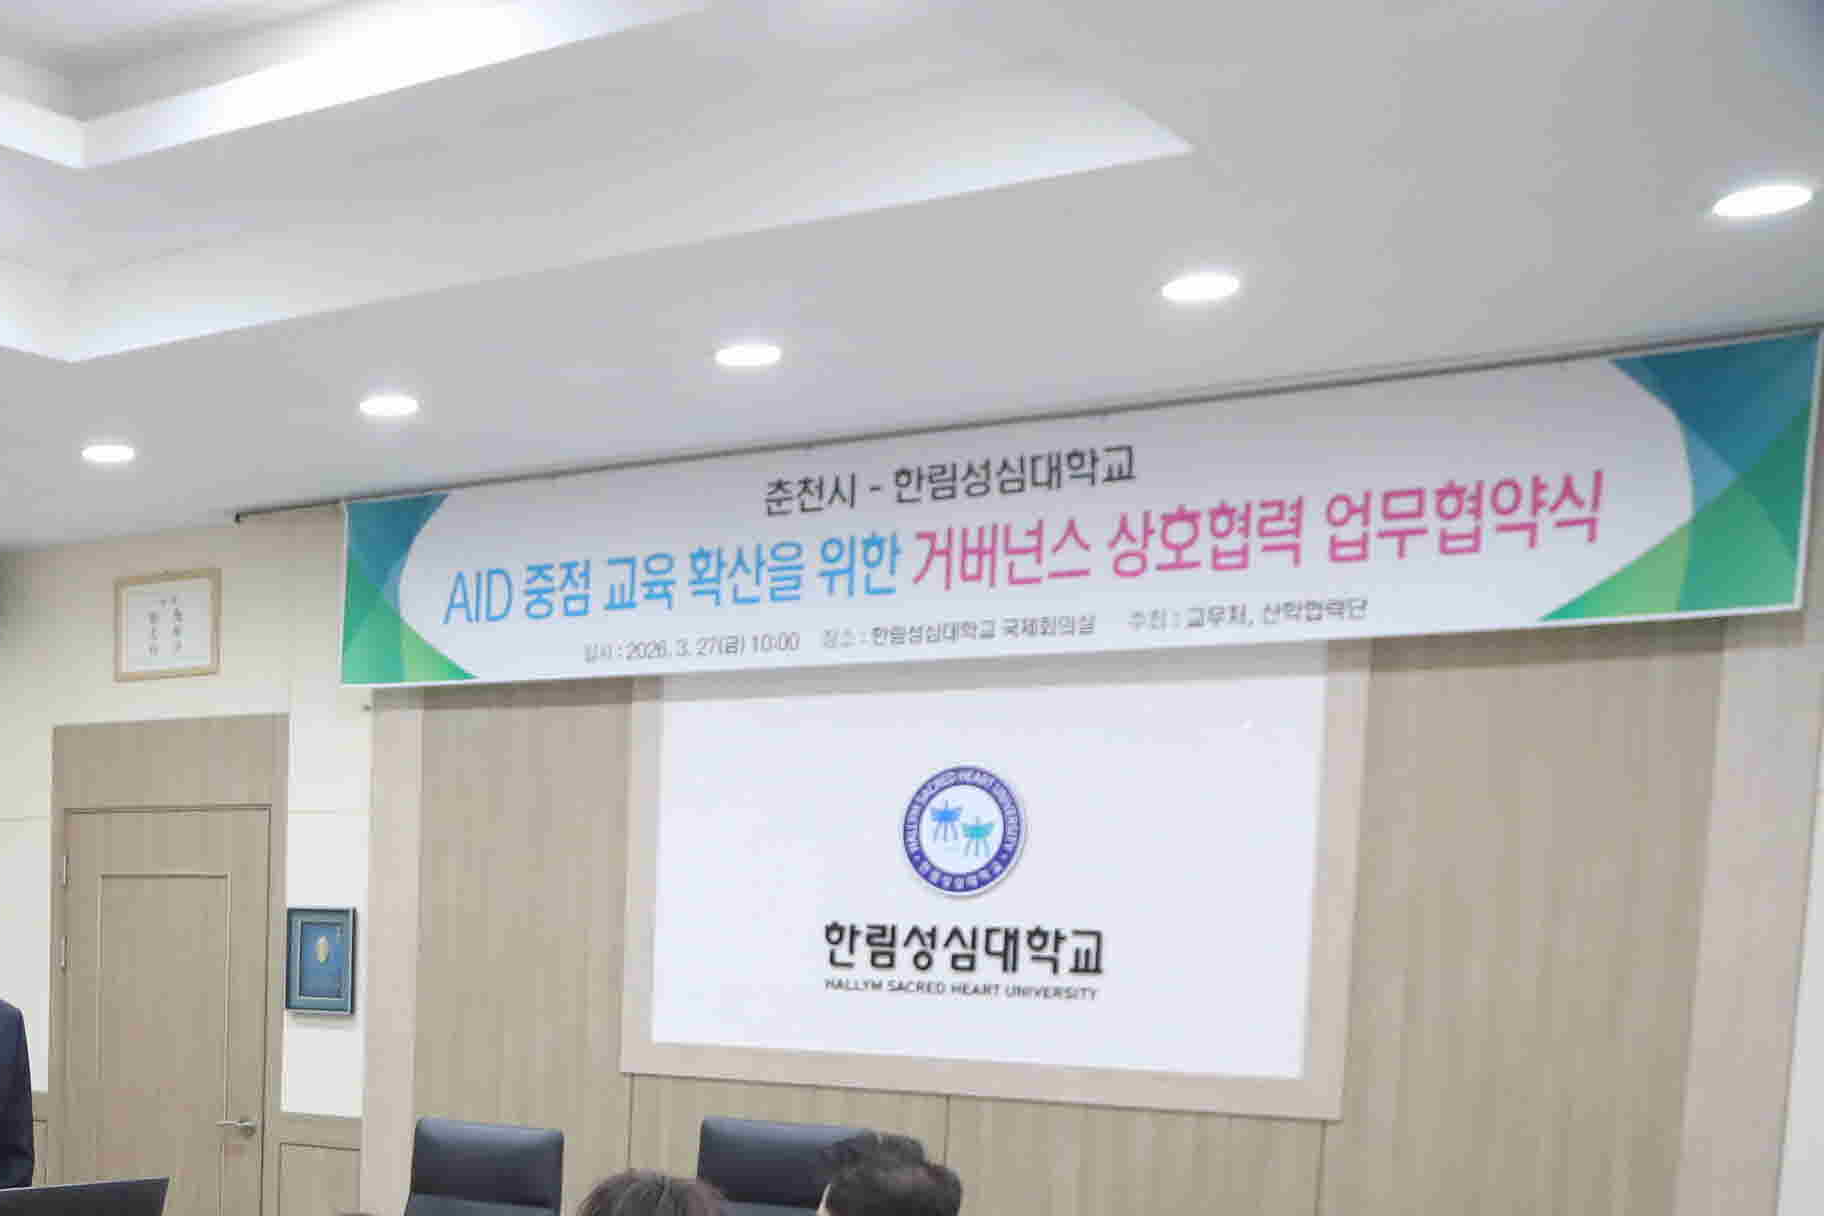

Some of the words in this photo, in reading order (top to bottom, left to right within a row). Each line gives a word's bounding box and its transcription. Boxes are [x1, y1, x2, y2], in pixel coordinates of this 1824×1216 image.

[764, 473, 857, 516] 춘천시
[894, 444, 1137, 504] 한림성심대학교
[442, 567, 514, 624] AID
[523, 557, 592, 619] 중점
[603, 550, 675, 611] 교육
[689, 538, 805, 607] 확산을
[818, 530, 902, 598] 위한
[912, 516, 1092, 592] 거버넌스
[1107, 494, 1305, 579] 상호협력
[1325, 468, 1605, 564] 업무협약식
[823, 920, 1104, 975] 한림성심대학교
[825, 977, 884, 993] HALLYM
[887, 979, 947, 996] SACRED
[950, 982, 1001, 998] HEART
[1004, 984, 1099, 1002] UNIVERSITY
